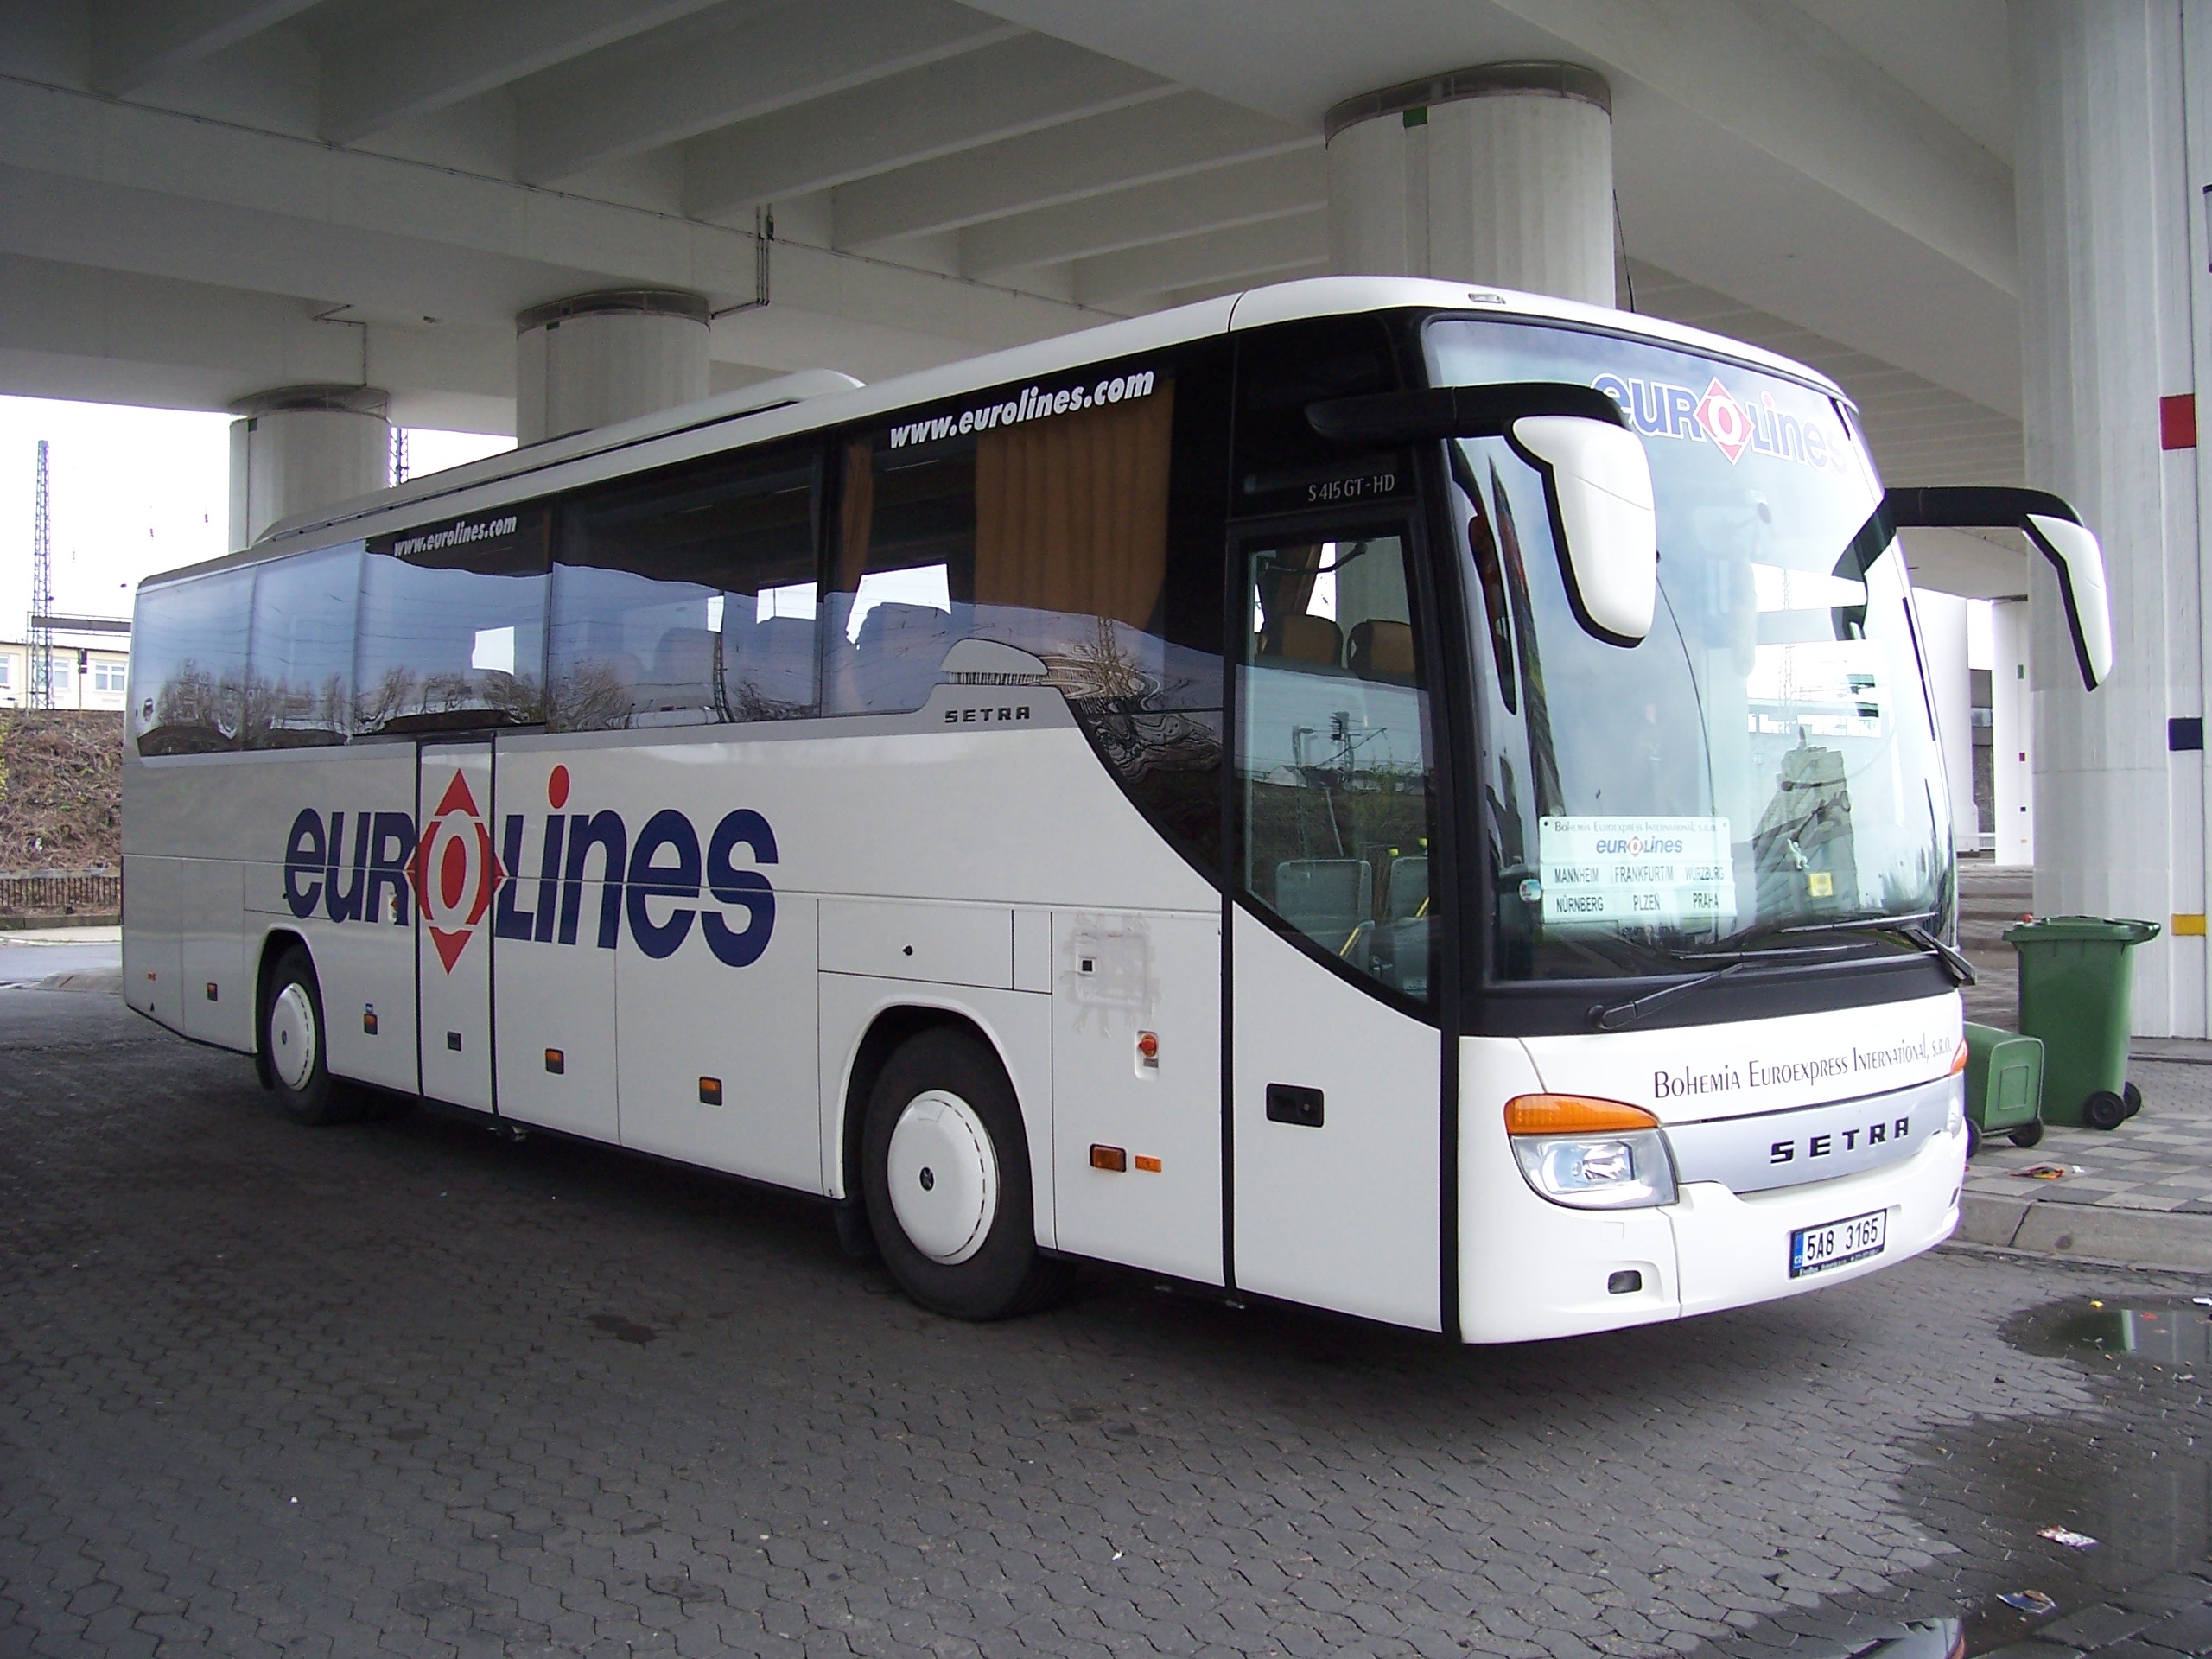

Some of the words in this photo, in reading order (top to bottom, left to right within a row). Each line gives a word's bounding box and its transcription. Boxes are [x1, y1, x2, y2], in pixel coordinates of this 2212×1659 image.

[889, 370, 1155, 450] www.eurolines.com
[1307, 484, 1317, 502] S
[1319, 481, 1341, 500] 415
[393, 516, 518, 557] www.eurolines.com
[944, 706, 1030, 723] SETRA
[1554, 868, 1599, 883] MANNHEIM
[1556, 894, 1605, 913] NÜRNBERG
[1693, 892, 1719, 909] PRAHA
[1770, 1116, 1909, 1164] SETRA
[1807, 1230, 1834, 1261] 5A8
[1846, 1217, 1878, 1250] 3165
